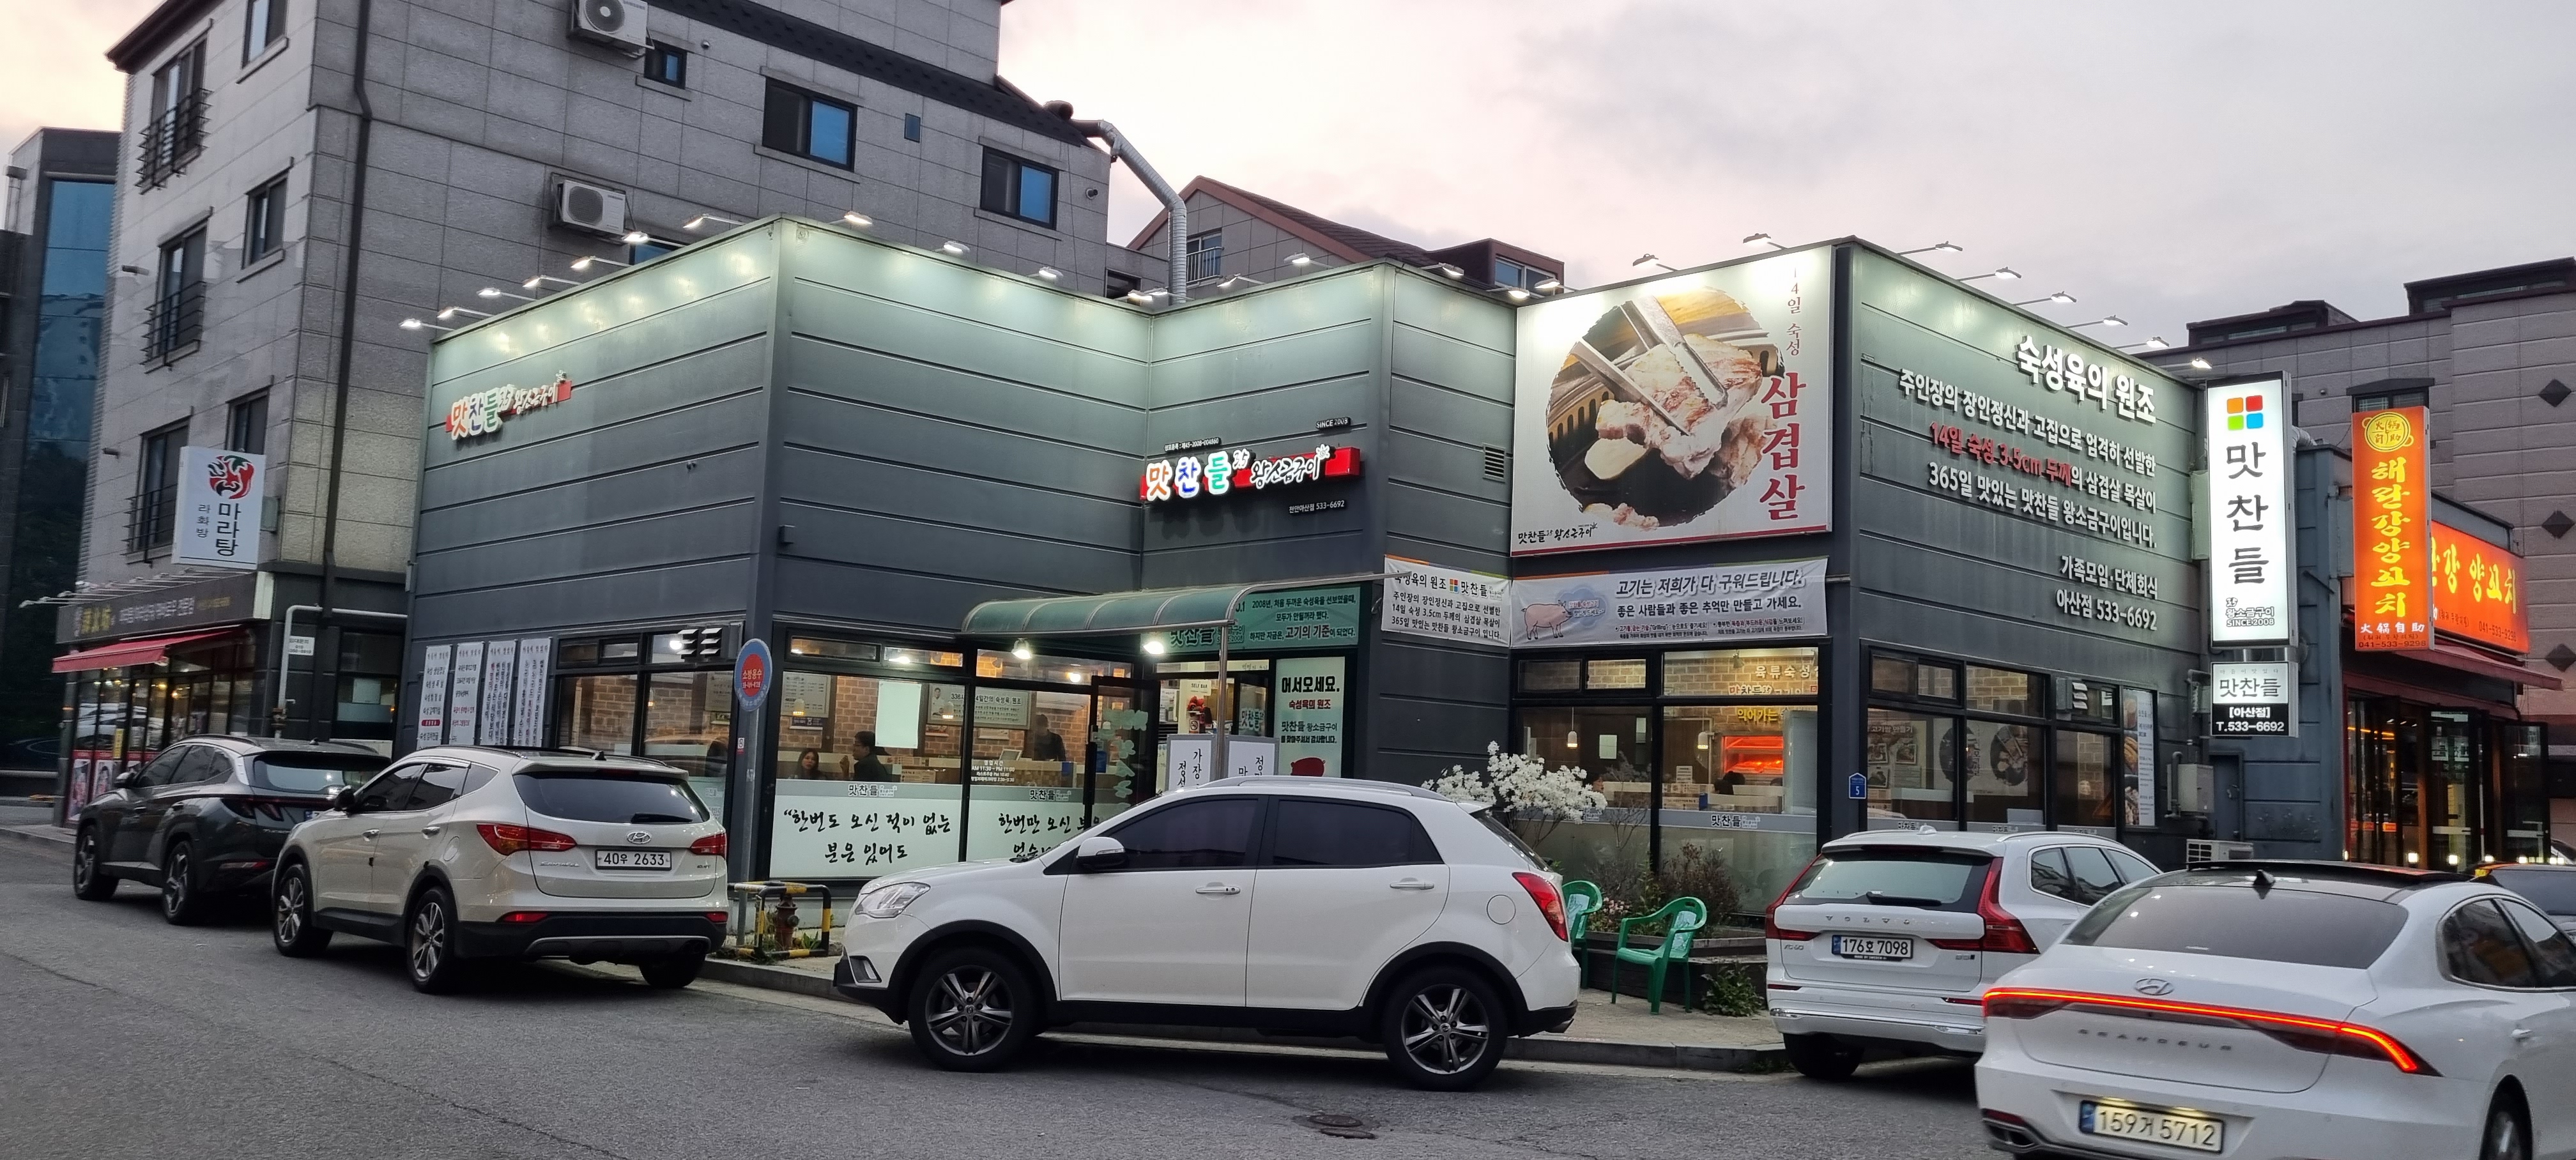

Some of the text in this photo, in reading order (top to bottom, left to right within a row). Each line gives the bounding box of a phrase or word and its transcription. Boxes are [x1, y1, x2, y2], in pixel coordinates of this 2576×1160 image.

[1786, 322, 1802, 356] 숙성
[2018, 335, 2156, 424] 숙성육의 원조
[452, 389, 500, 438] 맛찬들
[1316, 419, 1333, 428] SINCE
[1899, 369, 2156, 477] 주인장의 장인정신과 고집으로 엄격히 선발한
[1760, 372, 1806, 521] 삼겹살
[1147, 453, 1229, 500] 맛찬들
[1250, 455, 1320, 489] 왕소금구이
[1930, 422, 2156, 514] 14일 숙성 3.5cm 두께의 삼겹살 목살이
[1315, 500, 1345, 510] 533-6692
[1929, 462, 2156, 549] 365일 맛있는 맛찬들 왕소금구이입니다.
[2227, 441, 2270, 586] 맛찬들
[216, 503, 241, 556] 마라탕
[1518, 528, 1591, 544] 맛찬들 왕소금구이
[2371, 456, 2411, 618] 해란강양꼬치
[1430, 576, 1446, 589] 원조
[1461, 581, 1487, 597] 맛찬들
[1616, 569, 1802, 595] 고기는 저희가 다 구워드립니다.
[2469, 553, 2517, 614] 양꼬치
[1393, 591, 1419, 603] 주인장의
[1422, 597, 1453, 608] 장인정신과
[1455, 601, 1480, 612] 고집으로
[1617, 596, 1802, 618] 좋은 사람들과 좋은 추억만 만들고 가세요.
[2056, 589, 2157, 630] 아산점 533-6692
[2225, 606, 2274, 618] 왕소금구이
[1276, 613, 1292, 621] 모두가
[1393, 604, 1500, 628] 14일 숙성 3.5cm 두께의 삼겹살 목살이
[2227, 618, 2274, 627] SINCE 2008
[1250, 632, 1265, 640] 하지만
[1285, 625, 1310, 638] 고기의
[1314, 625, 1335, 637] 기준이
[1392, 616, 1501, 639] 365일 맛있는 맛찬들 왕소금구이 입니다.
[1282, 676, 1340, 692] 어서오세요.
[2220, 678, 2281, 698] 맛찬들
[1289, 699, 1331, 710] 숙성육의 원조
[1738, 708, 1778, 722] 익어가는
[2229, 706, 2271, 719] [아산점]
[1282, 721, 1338, 732] 맛찬들 왕소금구이
[2216, 721, 2284, 731] T.533-6692
[1192, 748, 1202, 779] 가장
[848, 784, 878, 796] 맛찬들
[1030, 790, 1055, 800] 맛찬들
[1856, 786, 1859, 795] 5
[851, 813, 879, 832] 오신
[886, 813, 914, 833] 적이
[923, 813, 951, 836] 없는
[999, 813, 1039, 834] 한번만
[1048, 816, 1071, 833] 오신
[1712, 815, 1741, 827] 맛찬들
[603, 853, 664, 866] 40우 2633
[825, 843, 908, 865] 분은 있어도
[1825, 915, 1910, 924] VOLVO
[1843, 939, 1909, 955] 176호 7098
[2099, 1110, 2216, 1146] 159거 5712
